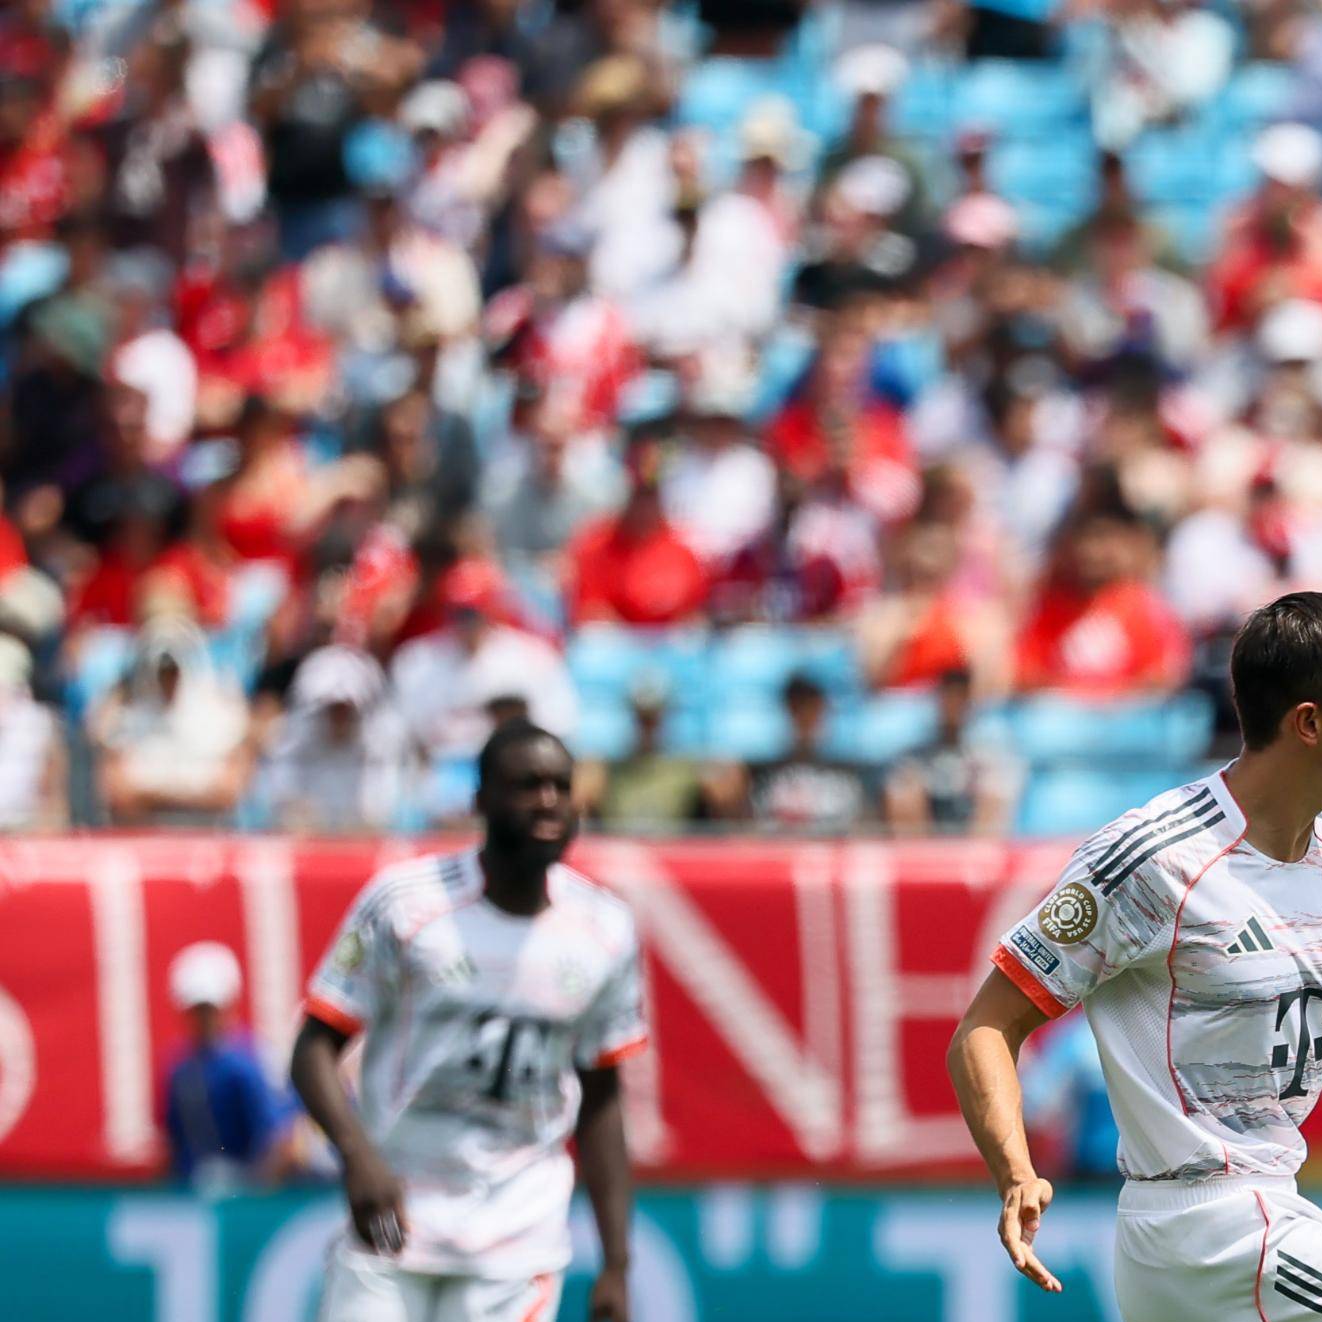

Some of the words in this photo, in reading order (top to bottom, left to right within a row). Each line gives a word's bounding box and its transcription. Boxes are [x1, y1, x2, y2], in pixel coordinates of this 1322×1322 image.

[1059, 888, 1085, 899] WORLD
[1083, 899, 1092, 916] CUP
[1042, 917, 1061, 939] FIFA
